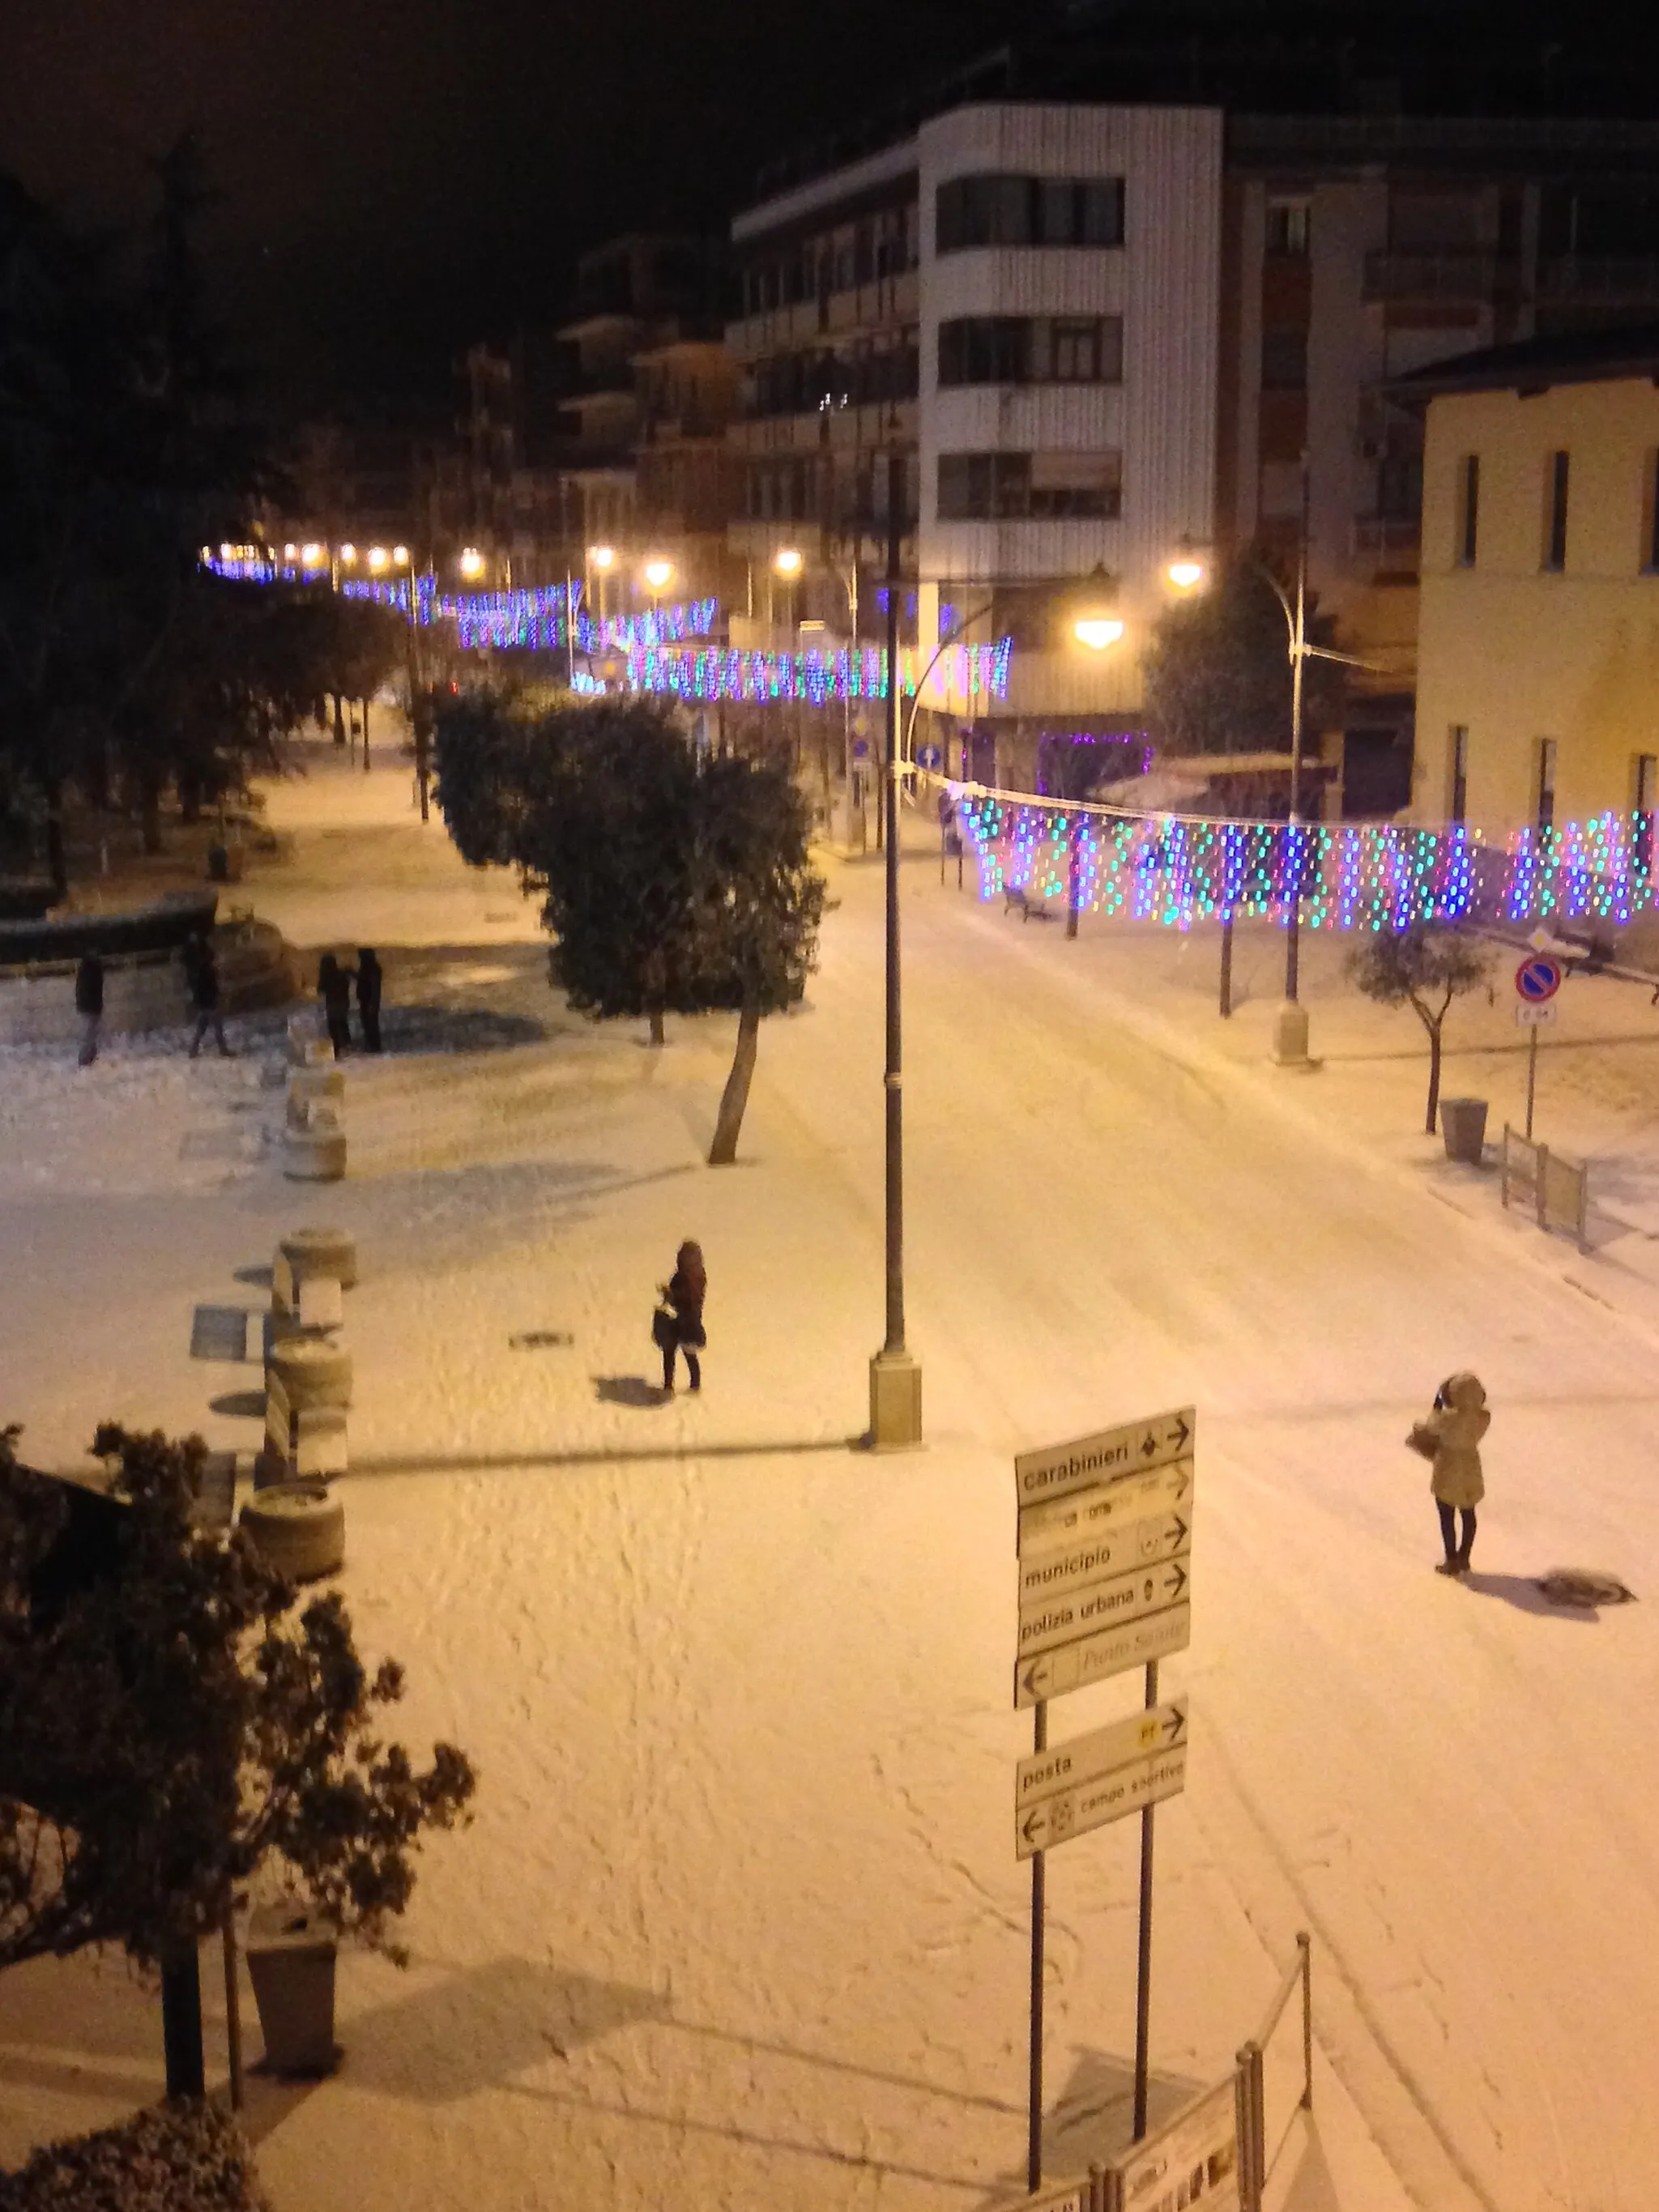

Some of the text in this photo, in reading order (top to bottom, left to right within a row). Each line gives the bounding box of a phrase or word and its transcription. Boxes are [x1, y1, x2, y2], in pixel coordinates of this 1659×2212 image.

[1024, 1443, 1128, 1491] carabinieri
[1026, 1545, 1111, 1588] municipio
[1021, 1589, 1133, 1644] polizia urbana
[1023, 1757, 1071, 1793] posta
[1081, 1760, 1183, 1813] campo sportivo
